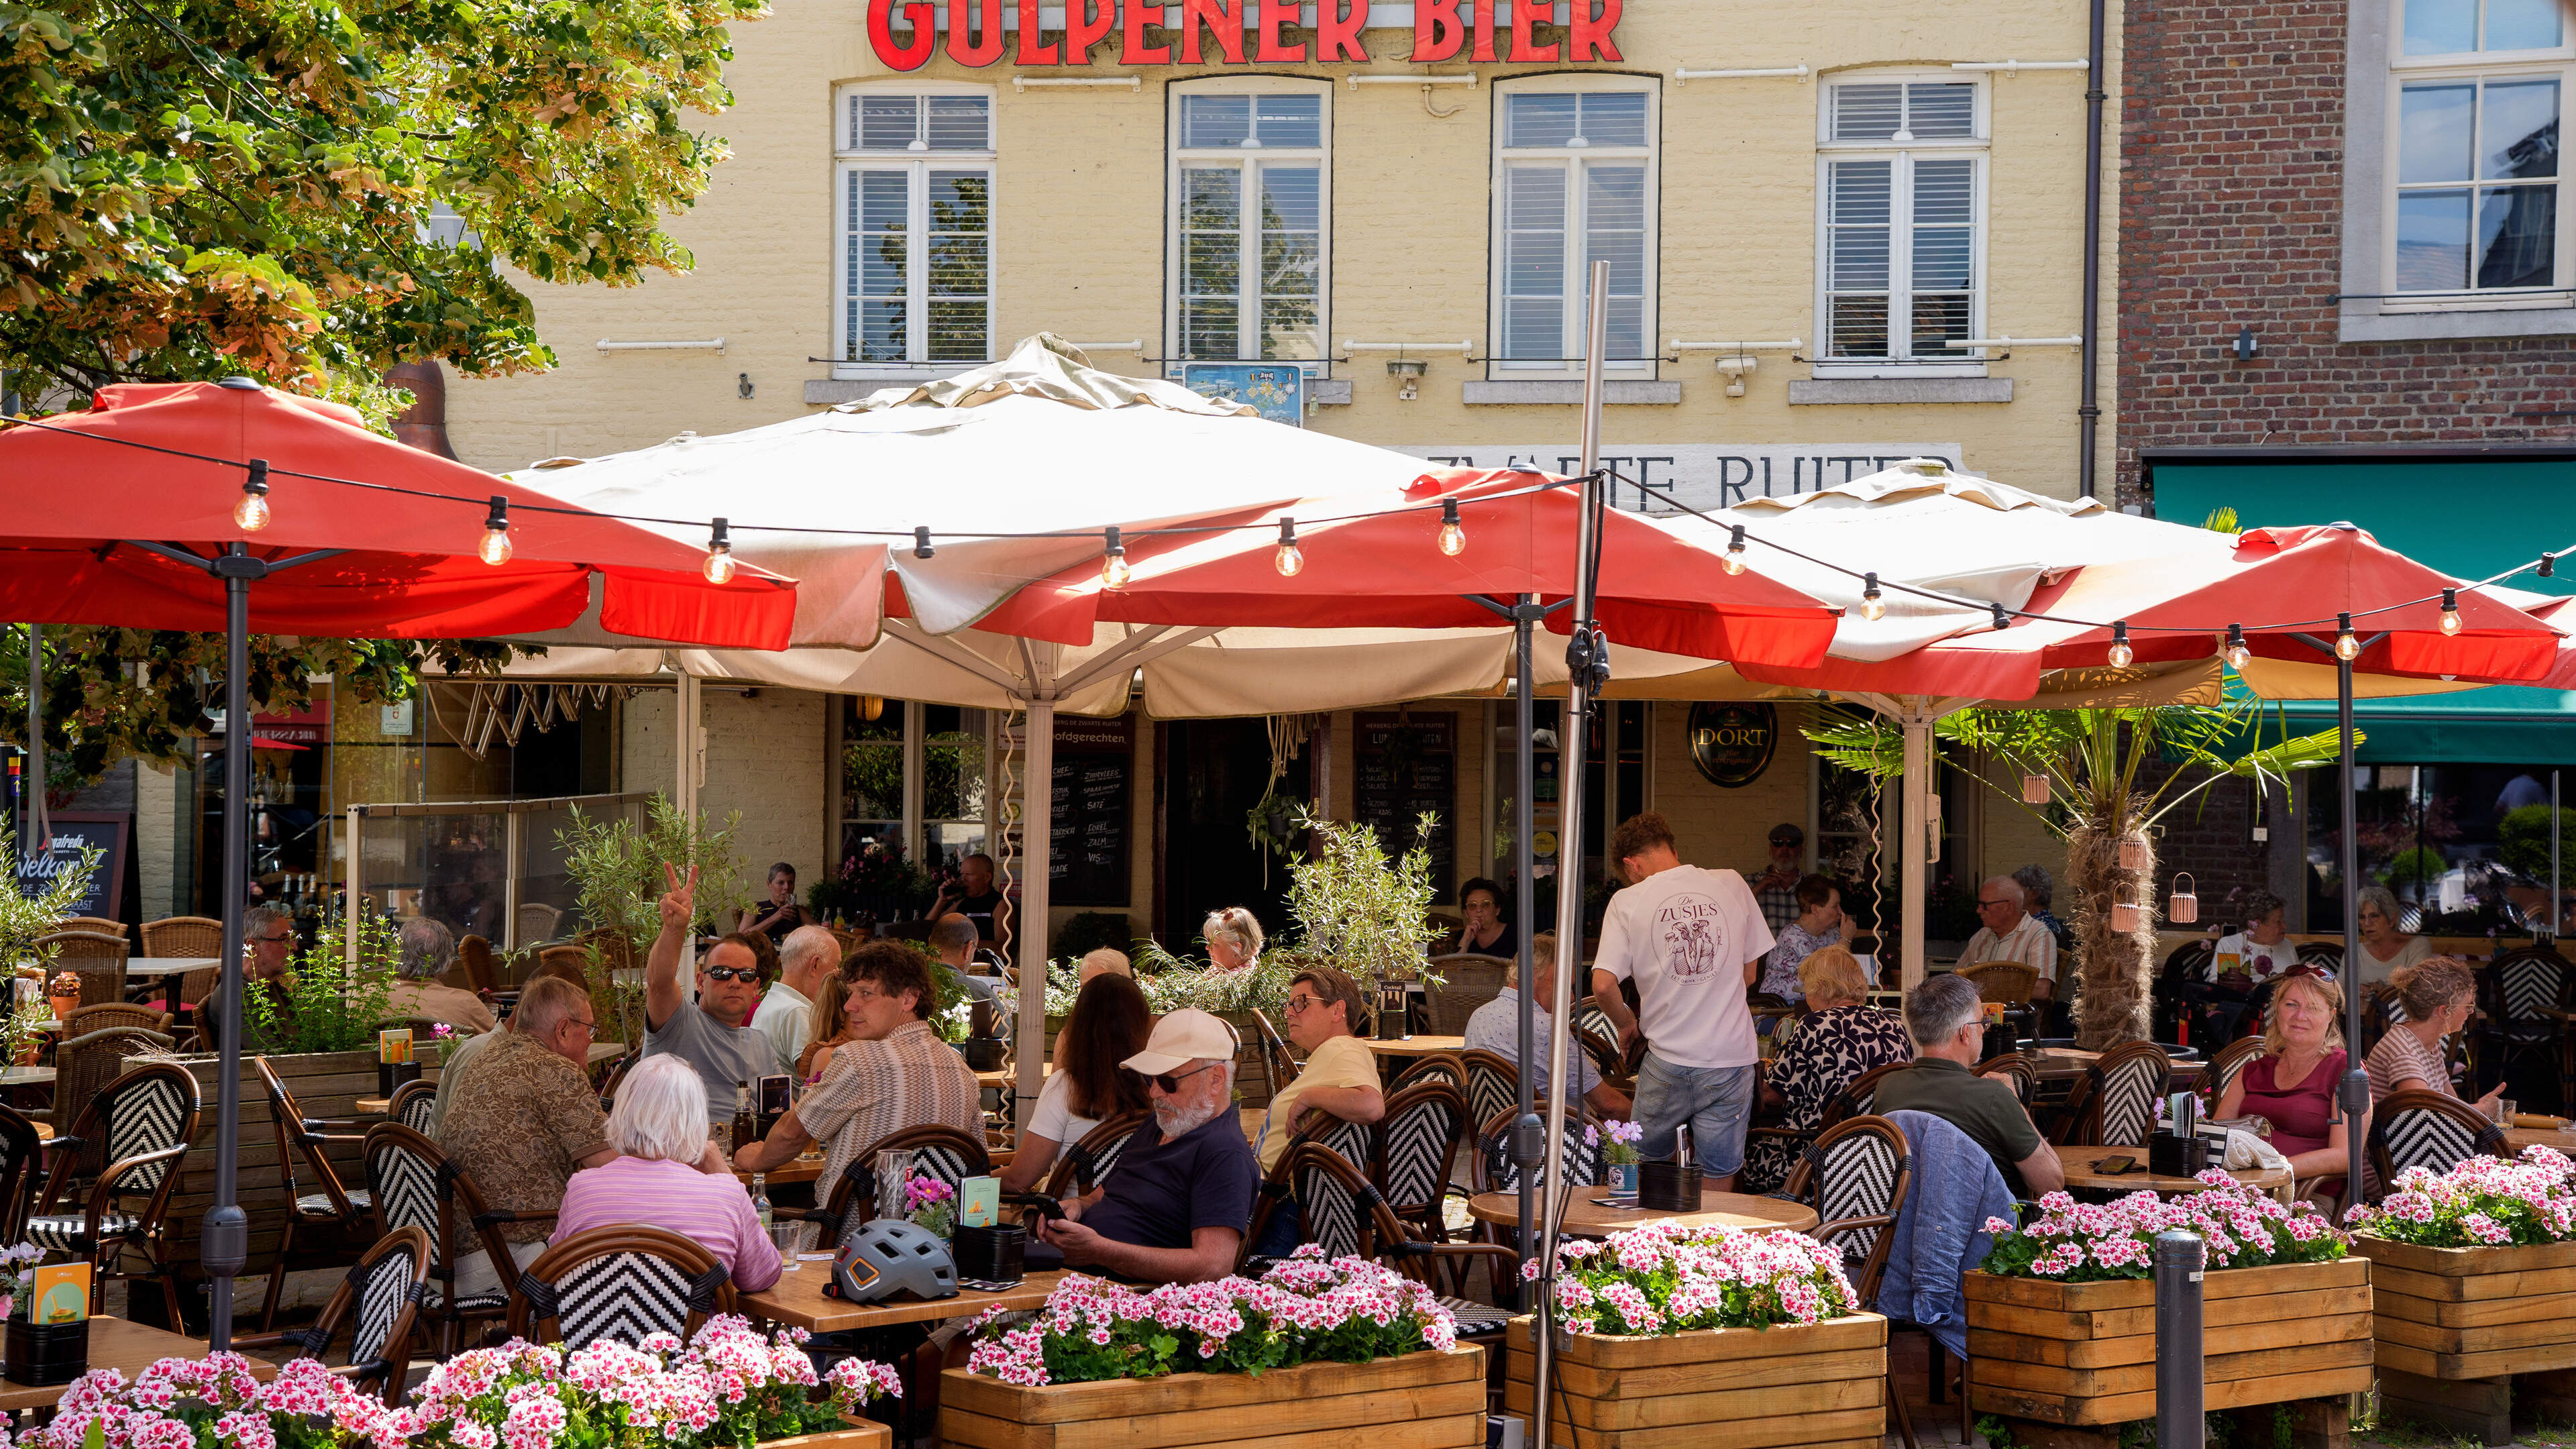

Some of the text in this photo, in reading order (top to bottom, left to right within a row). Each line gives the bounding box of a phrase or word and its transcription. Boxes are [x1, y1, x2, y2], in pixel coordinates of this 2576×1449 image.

[867, 0, 1624, 72] GULPENER BIER
[1717, 456, 1955, 508] RUIT
[1053, 731, 1126, 743] ofdgerechten
[1698, 728, 1768, 746] DORT
[1087, 837, 1107, 847] ZALM
[1088, 851, 1102, 863] VIS
[22, 883, 34, 892] DE
[1678, 896, 1695, 906] De
[1658, 903, 1718, 922] ZUSJES
